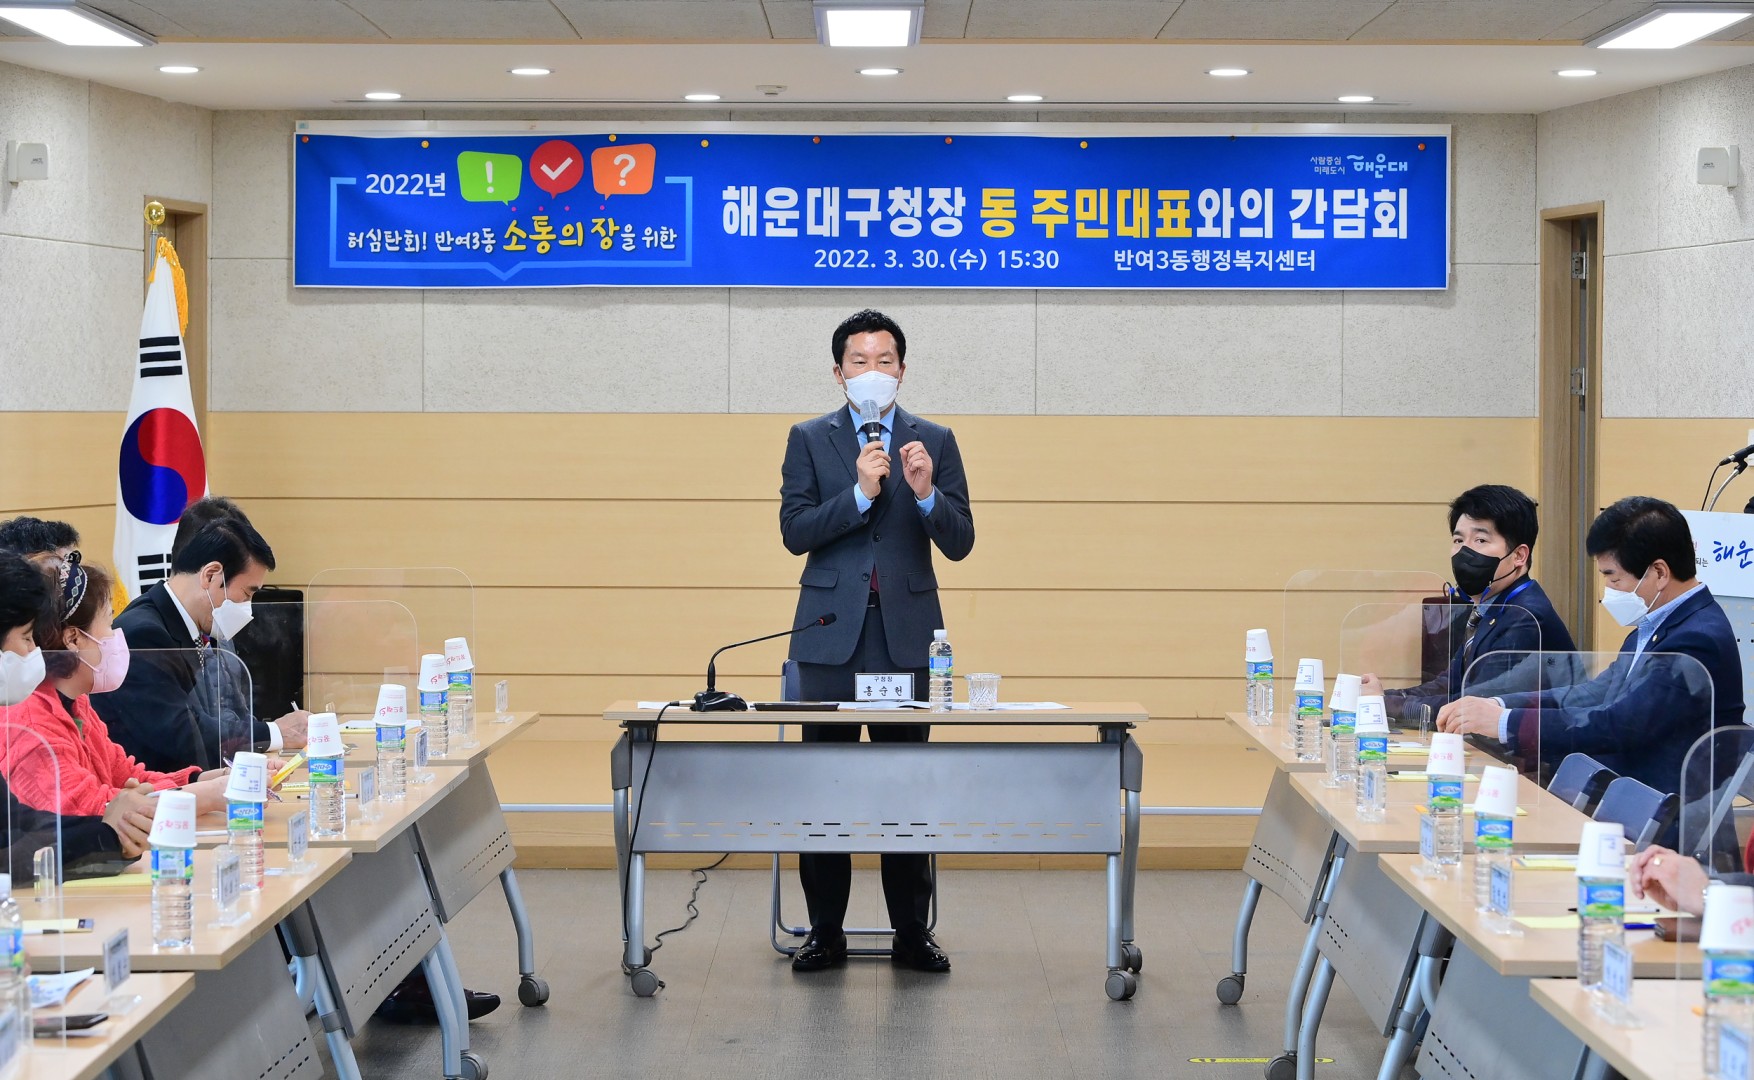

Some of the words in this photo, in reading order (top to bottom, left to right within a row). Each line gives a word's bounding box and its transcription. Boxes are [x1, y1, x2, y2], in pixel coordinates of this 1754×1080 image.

[1310, 156, 1341, 165] 사람중심
[1314, 166, 1345, 175] 미래도시
[1346, 153, 1408, 178] 해운대
[365, 172, 446, 198] 2022년
[722, 186, 966, 238] 해운대구청장
[980, 188, 1017, 238] 동
[1031, 189, 1274, 239] 주민대표와의
[1289, 188, 1408, 240] 간담회
[347, 229, 427, 253] 허심탄회!
[434, 228, 497, 254] 반여3동
[502, 215, 584, 255] 소통의
[590, 217, 636, 252] 장을
[641, 226, 678, 249] 위한
[814, 249, 876, 268] 2022.
[884, 249, 904, 268] 3.
[998, 249, 1060, 269] 15:30
[1113, 249, 1316, 272] 반여3동행정복지센터
